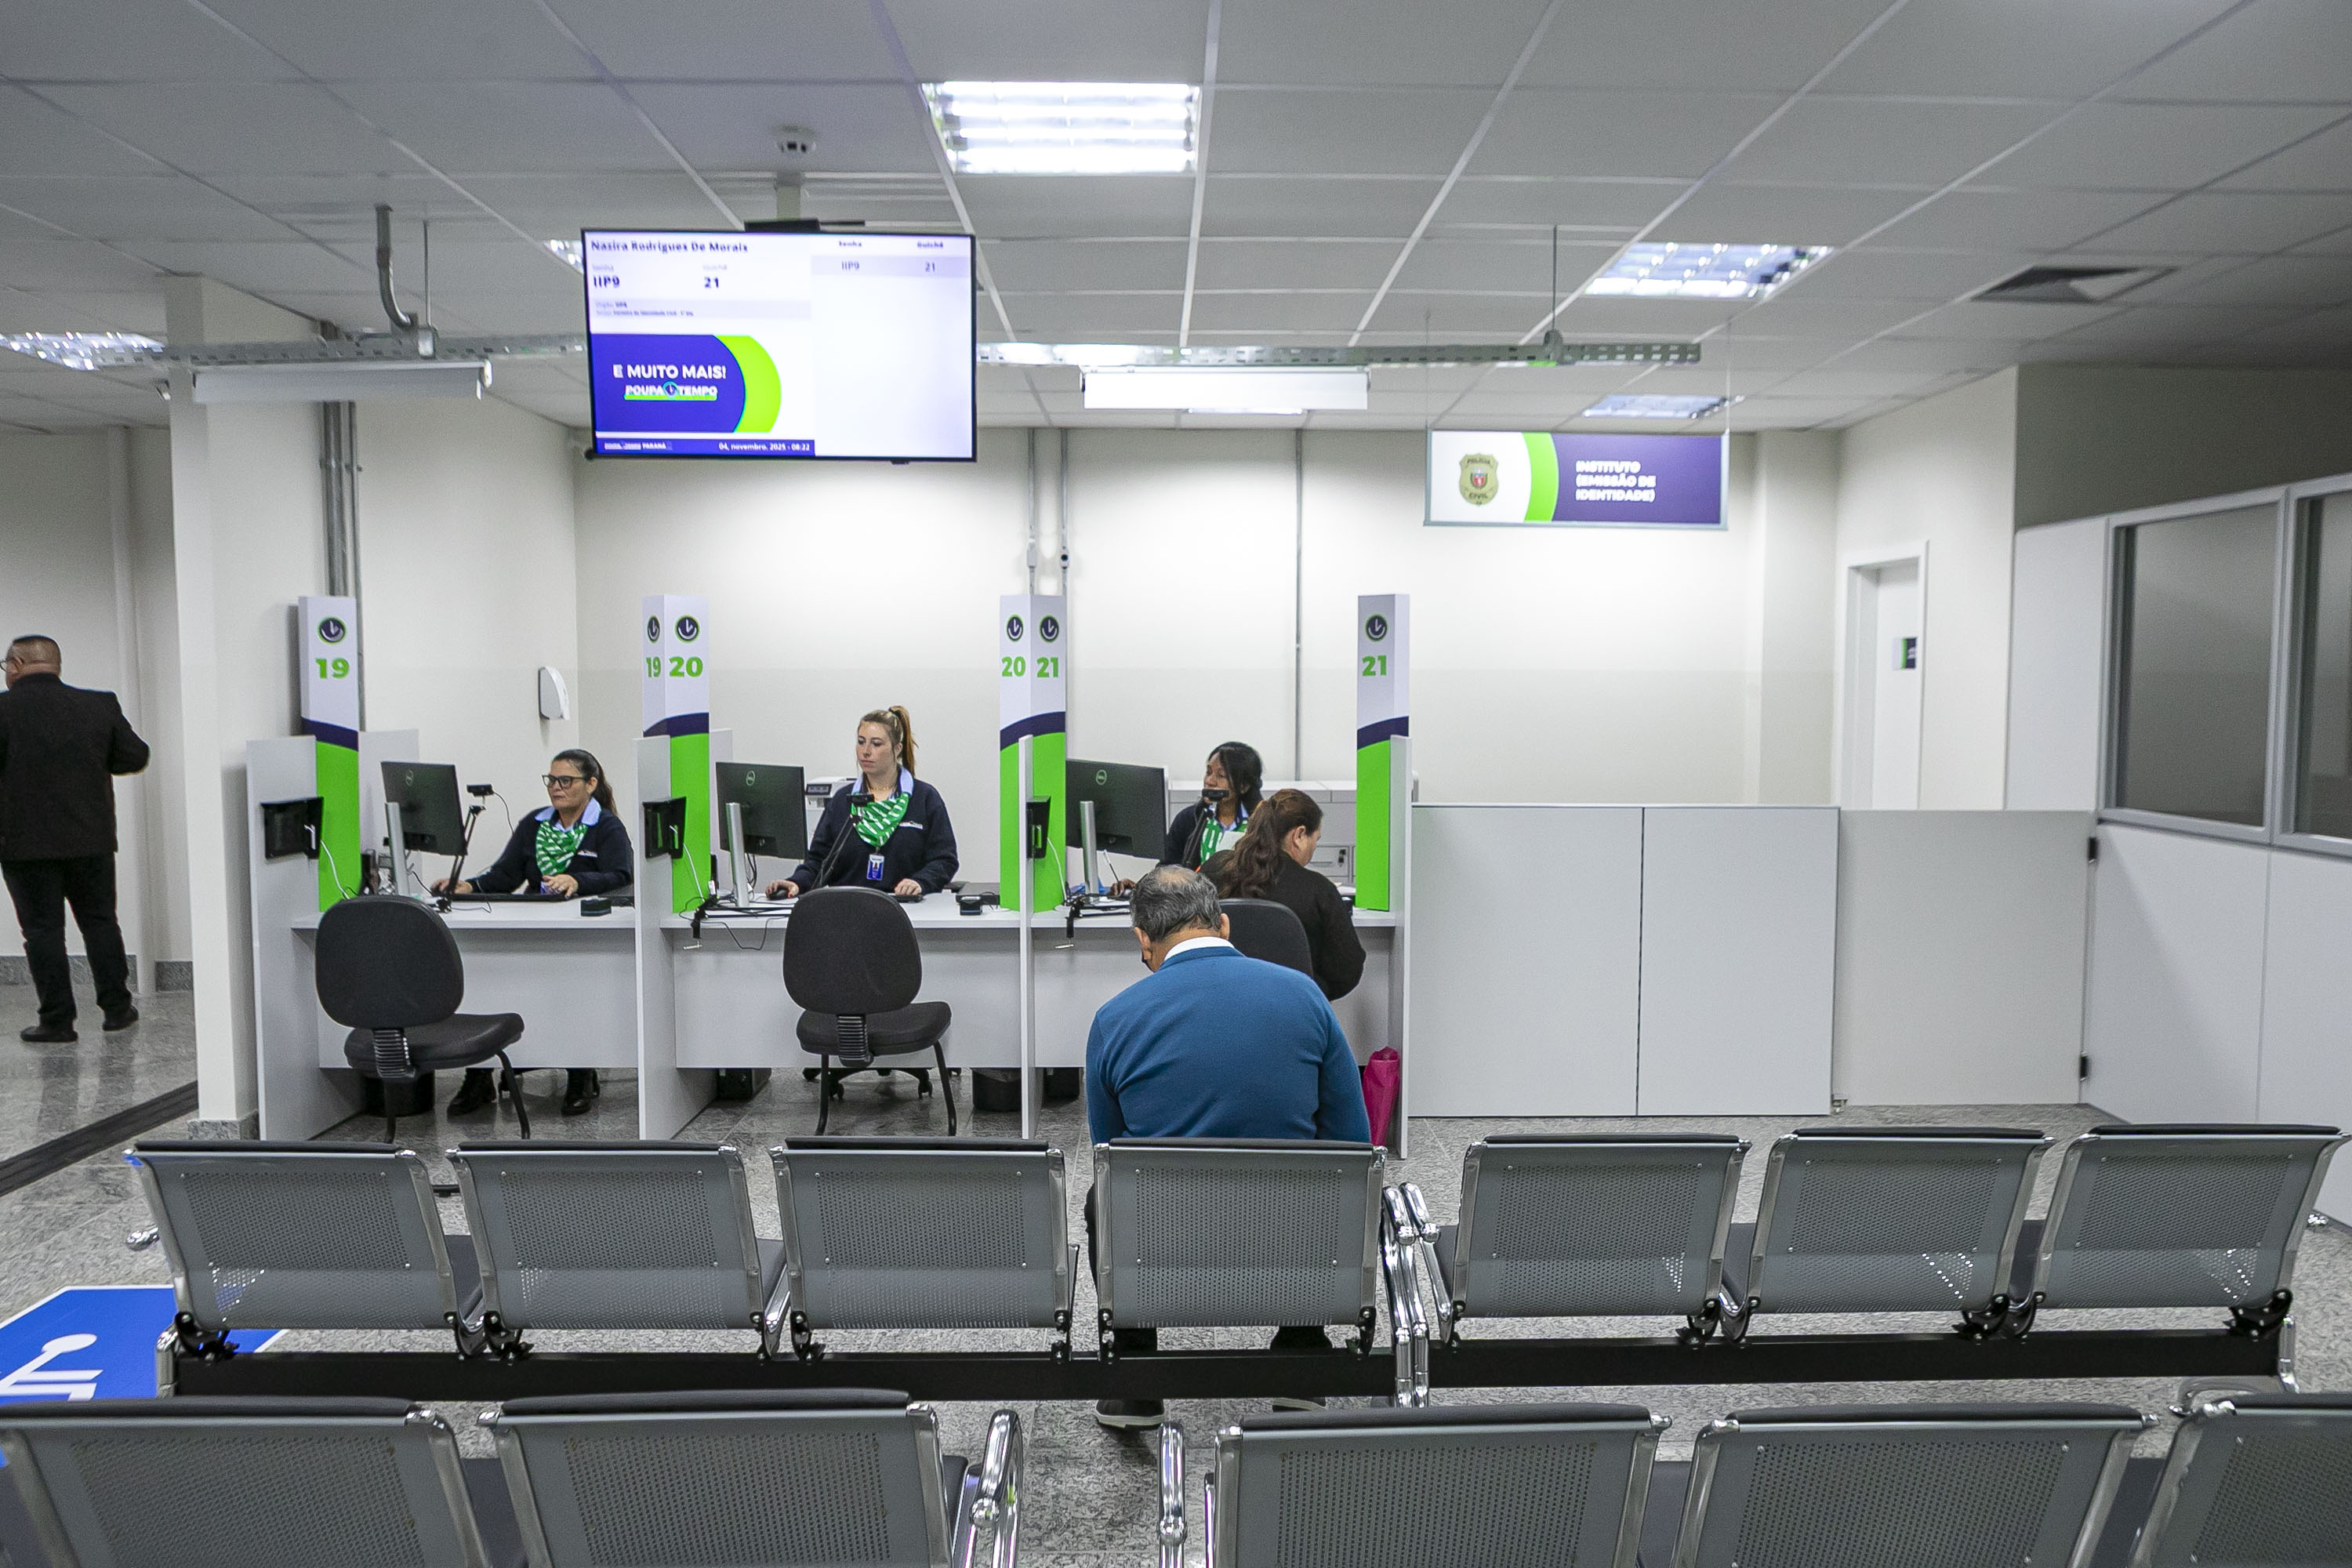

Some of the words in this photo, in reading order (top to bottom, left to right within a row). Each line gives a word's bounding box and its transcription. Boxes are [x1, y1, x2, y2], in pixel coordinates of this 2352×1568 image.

[691, 241, 706, 252] De
[924, 262, 935, 272] 21
[704, 277, 720, 289] 21
[612, 364, 623, 379] E
[627, 364, 679, 379] MUITO
[682, 365, 727, 379] MAIS!
[1575, 460, 1641, 474] INSTITUTO
[314, 657, 350, 680] 19
[645, 656, 662, 678] 19
[668, 656, 704, 678] 20
[1001, 655, 1026, 677] 20
[1036, 656, 1059, 678] 21
[1362, 655, 1387, 677] 21
